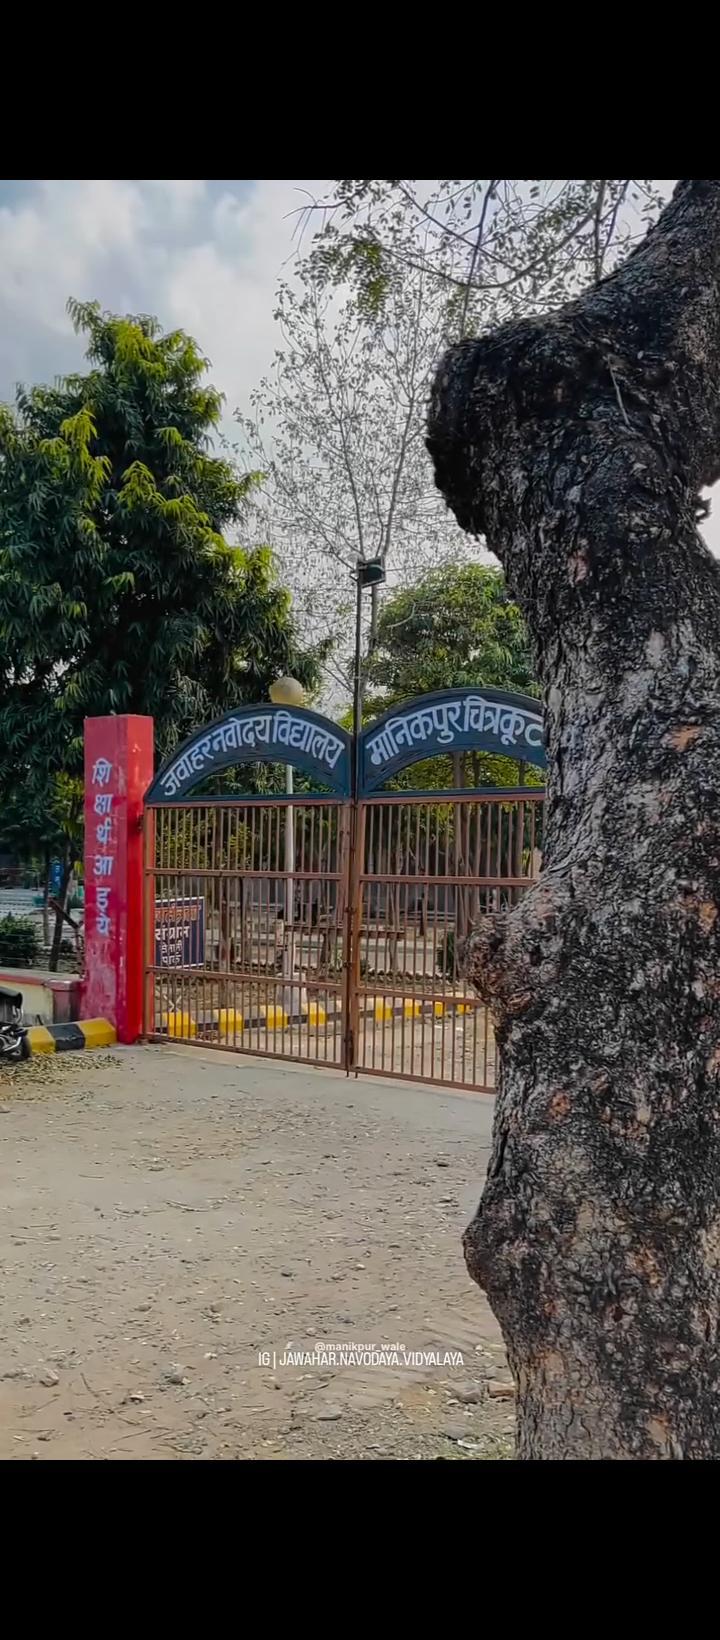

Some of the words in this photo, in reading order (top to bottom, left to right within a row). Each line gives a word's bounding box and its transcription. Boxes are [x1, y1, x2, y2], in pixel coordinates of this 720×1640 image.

[159, 739, 213, 797] जवाहर
[212, 714, 273, 754] नवोदय
[272, 711, 346, 769] विद्यालय
[364, 701, 463, 766] मानिकपुर
